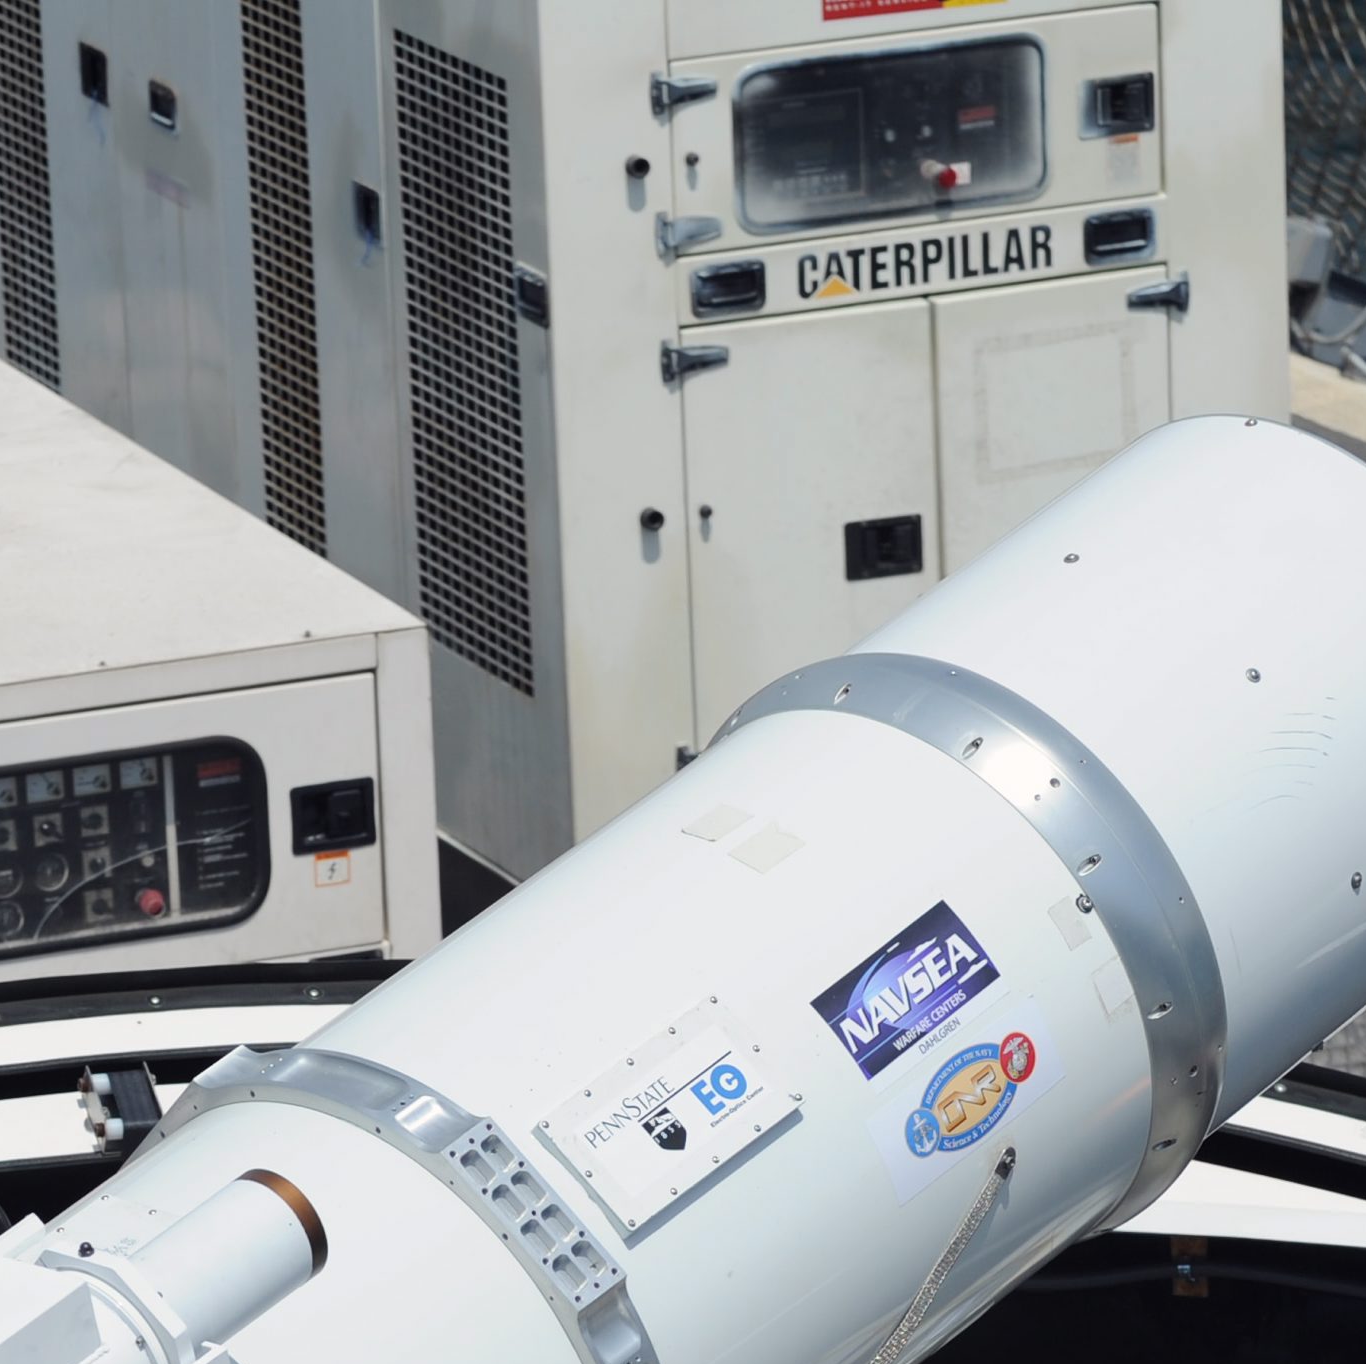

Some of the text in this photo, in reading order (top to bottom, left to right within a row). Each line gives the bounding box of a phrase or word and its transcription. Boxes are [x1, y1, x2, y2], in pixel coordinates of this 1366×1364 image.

[797, 224, 1053, 299] CATERPILLAR
[839, 933, 979, 1055] NAVSEA
[892, 989, 967, 1052] WARFARE CENTERS
[917, 1016, 962, 1055] DAHLGREN
[746, 1086, 764, 1101] Center
[943, 1090, 1014, 1150] Science & Technology
